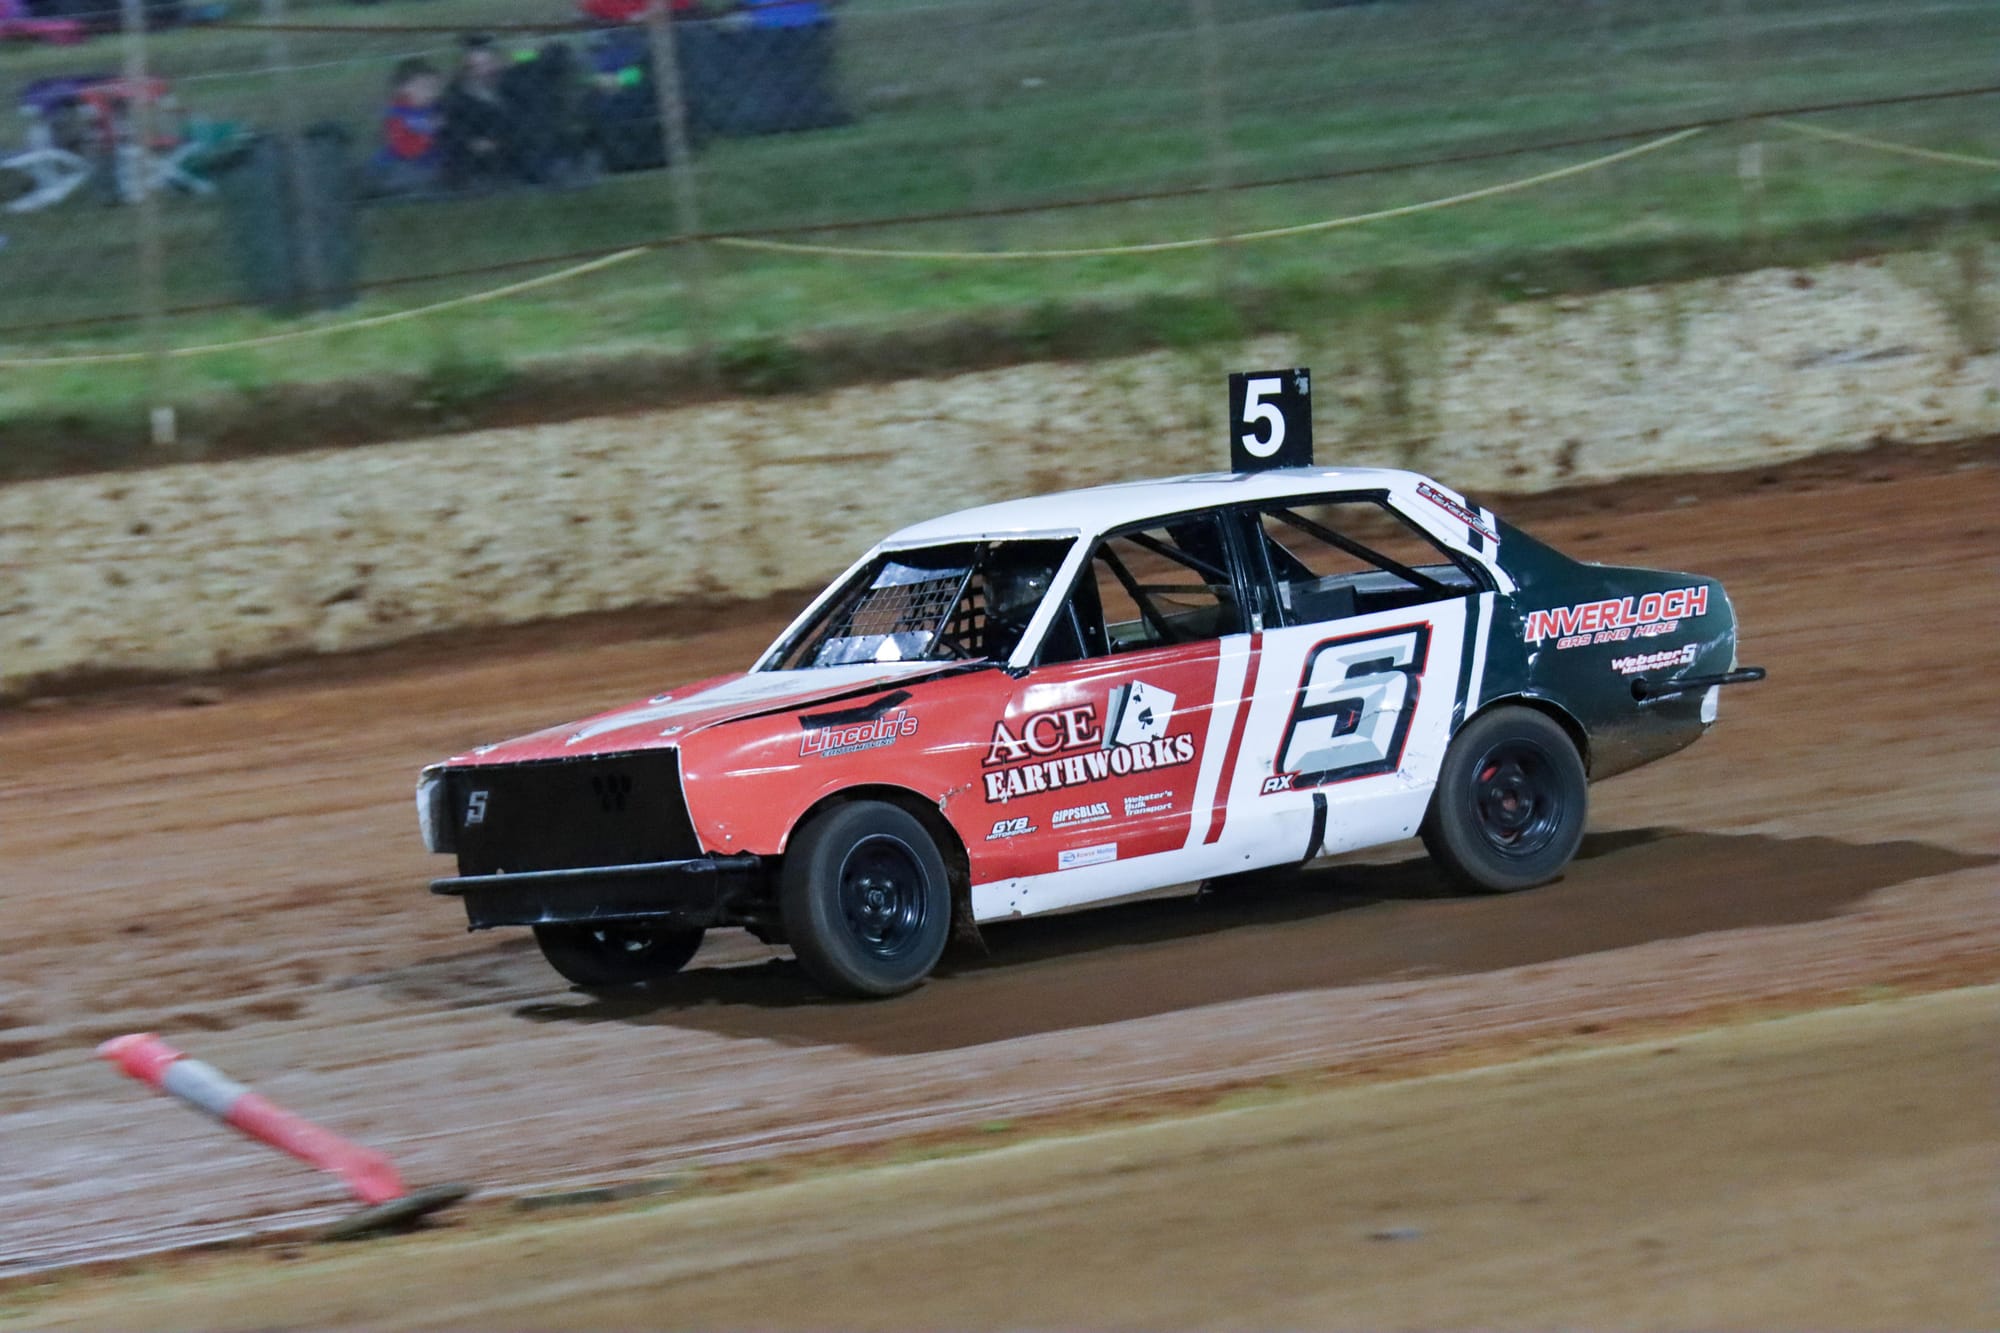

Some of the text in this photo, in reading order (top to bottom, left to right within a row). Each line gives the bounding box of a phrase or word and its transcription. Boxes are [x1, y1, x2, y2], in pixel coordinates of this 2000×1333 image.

[1241, 377, 1286, 457] 5
[1524, 585, 1709, 642] INVERLOCH
[1557, 620, 1679, 650] GAS AND HIRE
[1611, 649, 1682, 671] Webster
[1621, 658, 1680, 675] Motorsport
[1277, 624, 1430, 787] 5
[799, 709, 918, 757] Lincoln's
[982, 703, 1101, 767] ACE
[984, 732, 1196, 802] EARTHWORKS
[467, 790, 489, 824] 5
[1124, 790, 1172, 804] Webster's
[1125, 803, 1172, 817] Transport
[992, 816, 1029, 835] GYB
[1052, 802, 1110, 824] GIPPSBLAST
[985, 826, 1038, 841] MOTORSPORT
